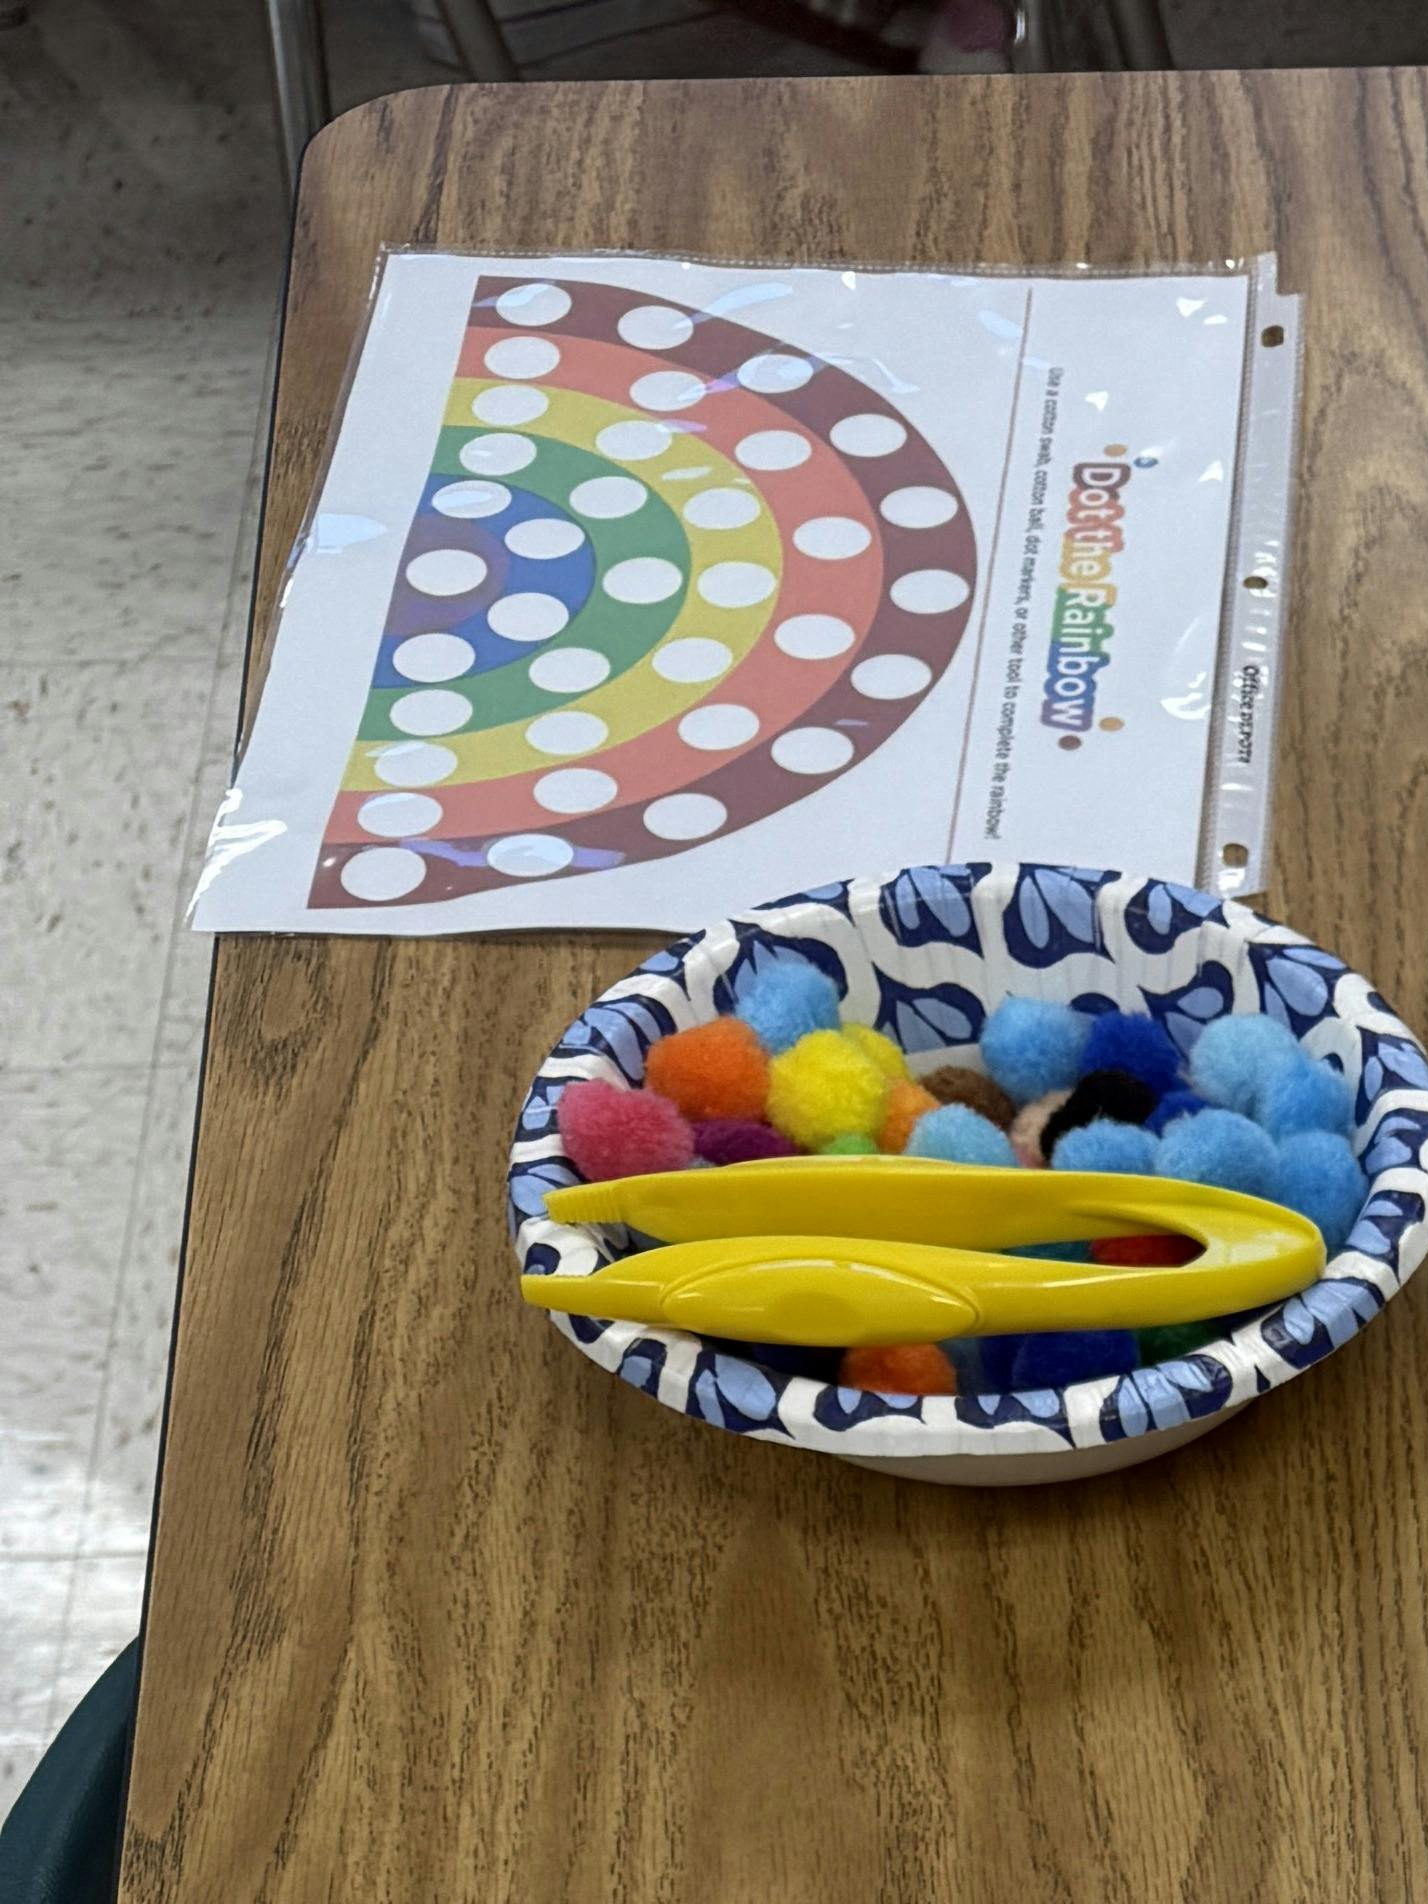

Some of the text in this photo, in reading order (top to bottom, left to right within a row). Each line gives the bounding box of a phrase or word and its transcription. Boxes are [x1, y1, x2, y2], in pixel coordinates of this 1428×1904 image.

[984, 368, 1064, 840] Use a cotton swab, cotton ball, dot markers, or other tool to complete the rainbow!
[1050, 466, 1121, 725] Dot the Rainbow
